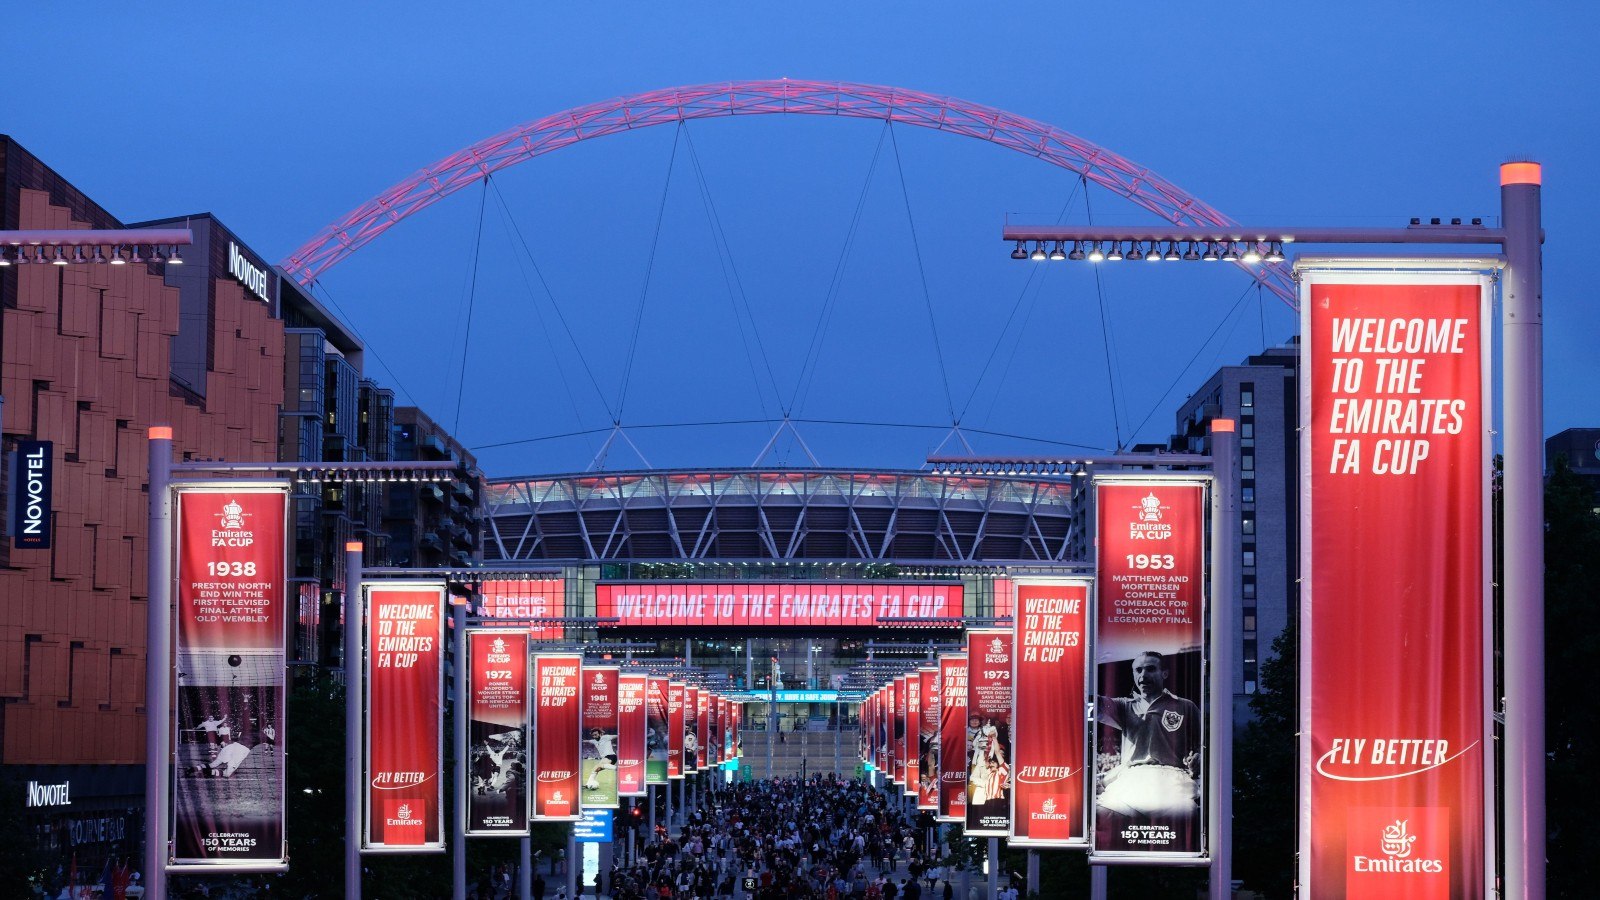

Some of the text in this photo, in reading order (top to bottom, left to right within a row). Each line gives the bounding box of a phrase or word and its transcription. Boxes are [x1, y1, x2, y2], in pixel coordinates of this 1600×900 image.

[1331, 317, 1468, 354] WELCOME
[1331, 358, 1426, 394] TO THE
[1329, 398, 1466, 435] EMIRATES
[1329, 439, 1430, 475] FA CUP
[1130, 522, 1171, 531] Emirates
[212, 530, 253, 538] Emirates
[1130, 531, 1172, 540] FA CUP
[212, 538, 253, 547] FA CUP
[1126, 554, 1175, 570] 1953
[207, 561, 257, 577] 1938
[1112, 575, 1189, 583] MATTHEWS AND
[192, 582, 272, 590] PRESTON NORTH
[1121, 583, 1180, 591] MORTENSEN
[200, 590, 264, 598] END WIN THE
[496, 595, 546, 605] Emirates
[1114, 599, 1166, 607] COMEBACK
[616, 594, 945, 618] WELCOME TO THE EMIRATES FA CUP
[1025, 598, 1081, 614] WELCOME
[379, 604, 434, 620] WELCOME
[496, 606, 513, 617] FA
[515, 606, 547, 617] CUP
[222, 615, 269, 623] WEMBLEY
[1025, 614, 1064, 630] TO THE
[1108, 616, 1193, 624] LEGENDARY FINAL
[378, 620, 417, 635] TO THE
[1024, 630, 1080, 647] EMIRATES
[378, 636, 433, 652] EMIRATES
[378, 652, 418, 668] FA CUP
[1024, 647, 1065, 663] FA CUP
[485, 670, 512, 679] 1972
[541, 666, 577, 676] WELCOME
[945, 666, 967, 677] WELCO
[983, 670, 1010, 679] 1973
[541, 676, 566, 686] TO THE
[945, 676, 953, 686] TO
[541, 686, 576, 697] EMIRATES
[945, 687, 967, 697] EMIRA
[541, 696, 567, 707] FA CUP
[945, 697, 953, 707] FA
[1329, 738, 1449, 766] FLY BETTER
[540, 770, 571, 779] FLY BETTER
[1022, 765, 1070, 778] FLY BETTER
[377, 771, 425, 783] FLY BETTER
[1031, 812, 1067, 820] Emirates
[386, 818, 423, 826] Emirates
[1120, 831, 1177, 839] 150 YEARS
[201, 838, 257, 846] 150 YEARS
[1353, 855, 1442, 873] Emirates
